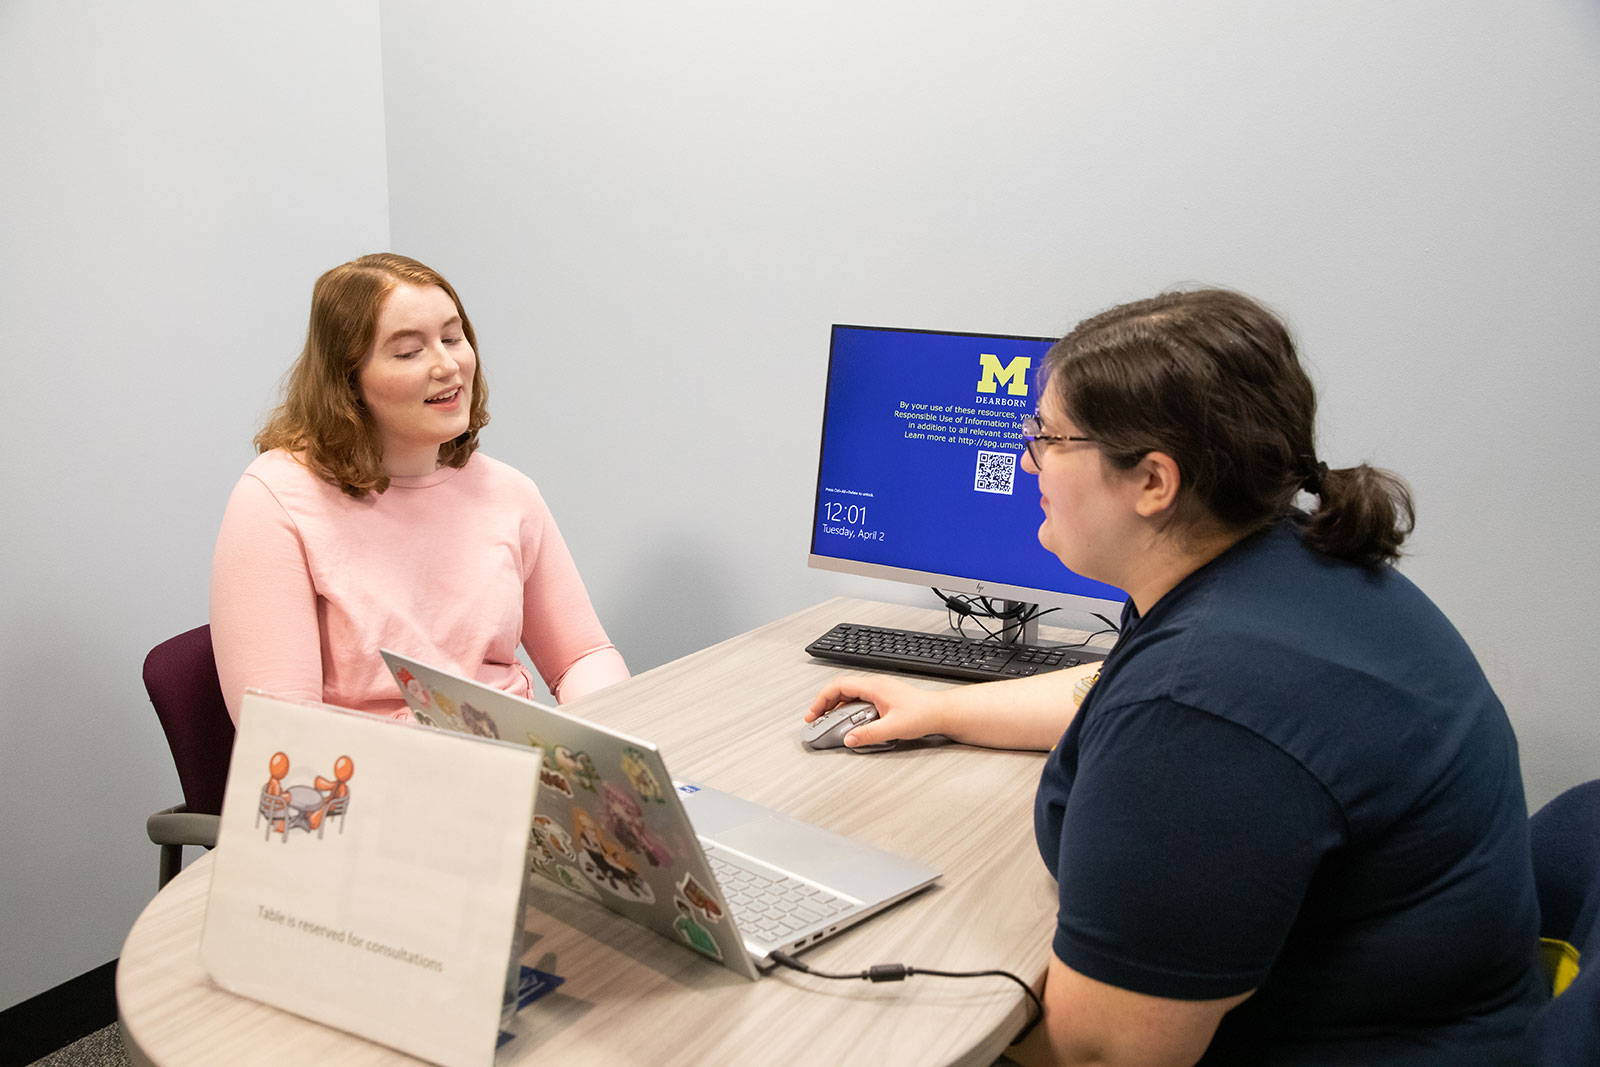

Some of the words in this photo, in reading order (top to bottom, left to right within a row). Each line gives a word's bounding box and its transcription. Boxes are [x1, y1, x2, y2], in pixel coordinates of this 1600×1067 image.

[976, 353, 1031, 396] M
[899, 401, 910, 410] By
[910, 402, 929, 412] your
[930, 404, 943, 412] use
[945, 405, 954, 413] of
[954, 405, 976, 415] these
[977, 409, 1018, 420] resources,
[975, 396, 1027, 408] DEARBORN
[894, 410, 938, 422] Responsible
[939, 414, 953, 424] Use
[954, 415, 964, 424] of
[965, 416, 1010, 428] Information
[1012, 421, 1024, 430] Re
[908, 421, 916, 429] in
[916, 422, 947, 432] addition
[949, 425, 957, 433] to
[958, 425, 968, 434] all
[969, 427, 1001, 438] relevant
[1003, 431, 1024, 440] state
[904, 431, 925, 440] Learn
[926, 434, 946, 442] more
[948, 435, 957, 443] at
[958, 436, 1027, 451] http://spg.umich.
[824, 502, 866, 525] 12:01
[822, 523, 856, 539] Tuesday,
[857, 529, 877, 541] April
[878, 532, 885, 541] 2
[257, 905, 286, 925] Table
[288, 912, 296, 928] is
[297, 918, 346, 943] reserved
[347, 930, 363, 947] for
[366, 939, 444, 973] consultations
